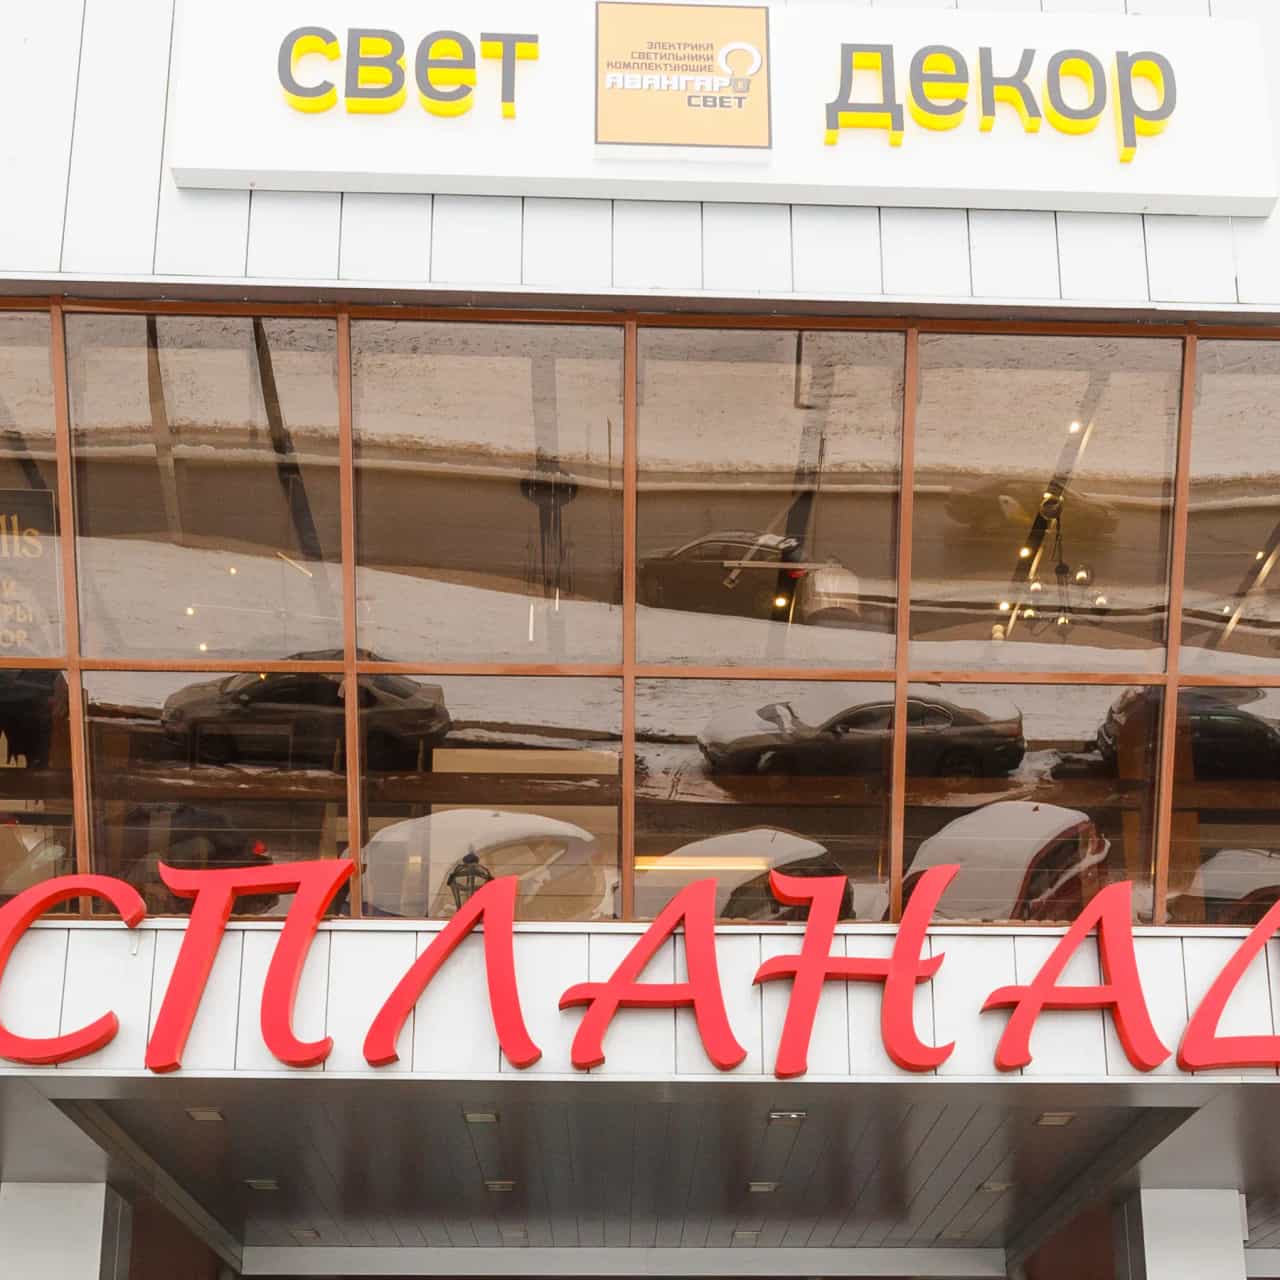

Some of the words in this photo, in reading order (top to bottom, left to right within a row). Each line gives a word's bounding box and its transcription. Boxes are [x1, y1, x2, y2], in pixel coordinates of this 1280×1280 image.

[631, 51, 714, 63] СВЕТИЛЬНИКИ
[277, 26, 539, 119] свет
[606, 61, 714, 73] КОМПЛЕКТУЮЩИЕ
[687, 95, 747, 109] СВЕТ
[824, 42, 1177, 163] декор
